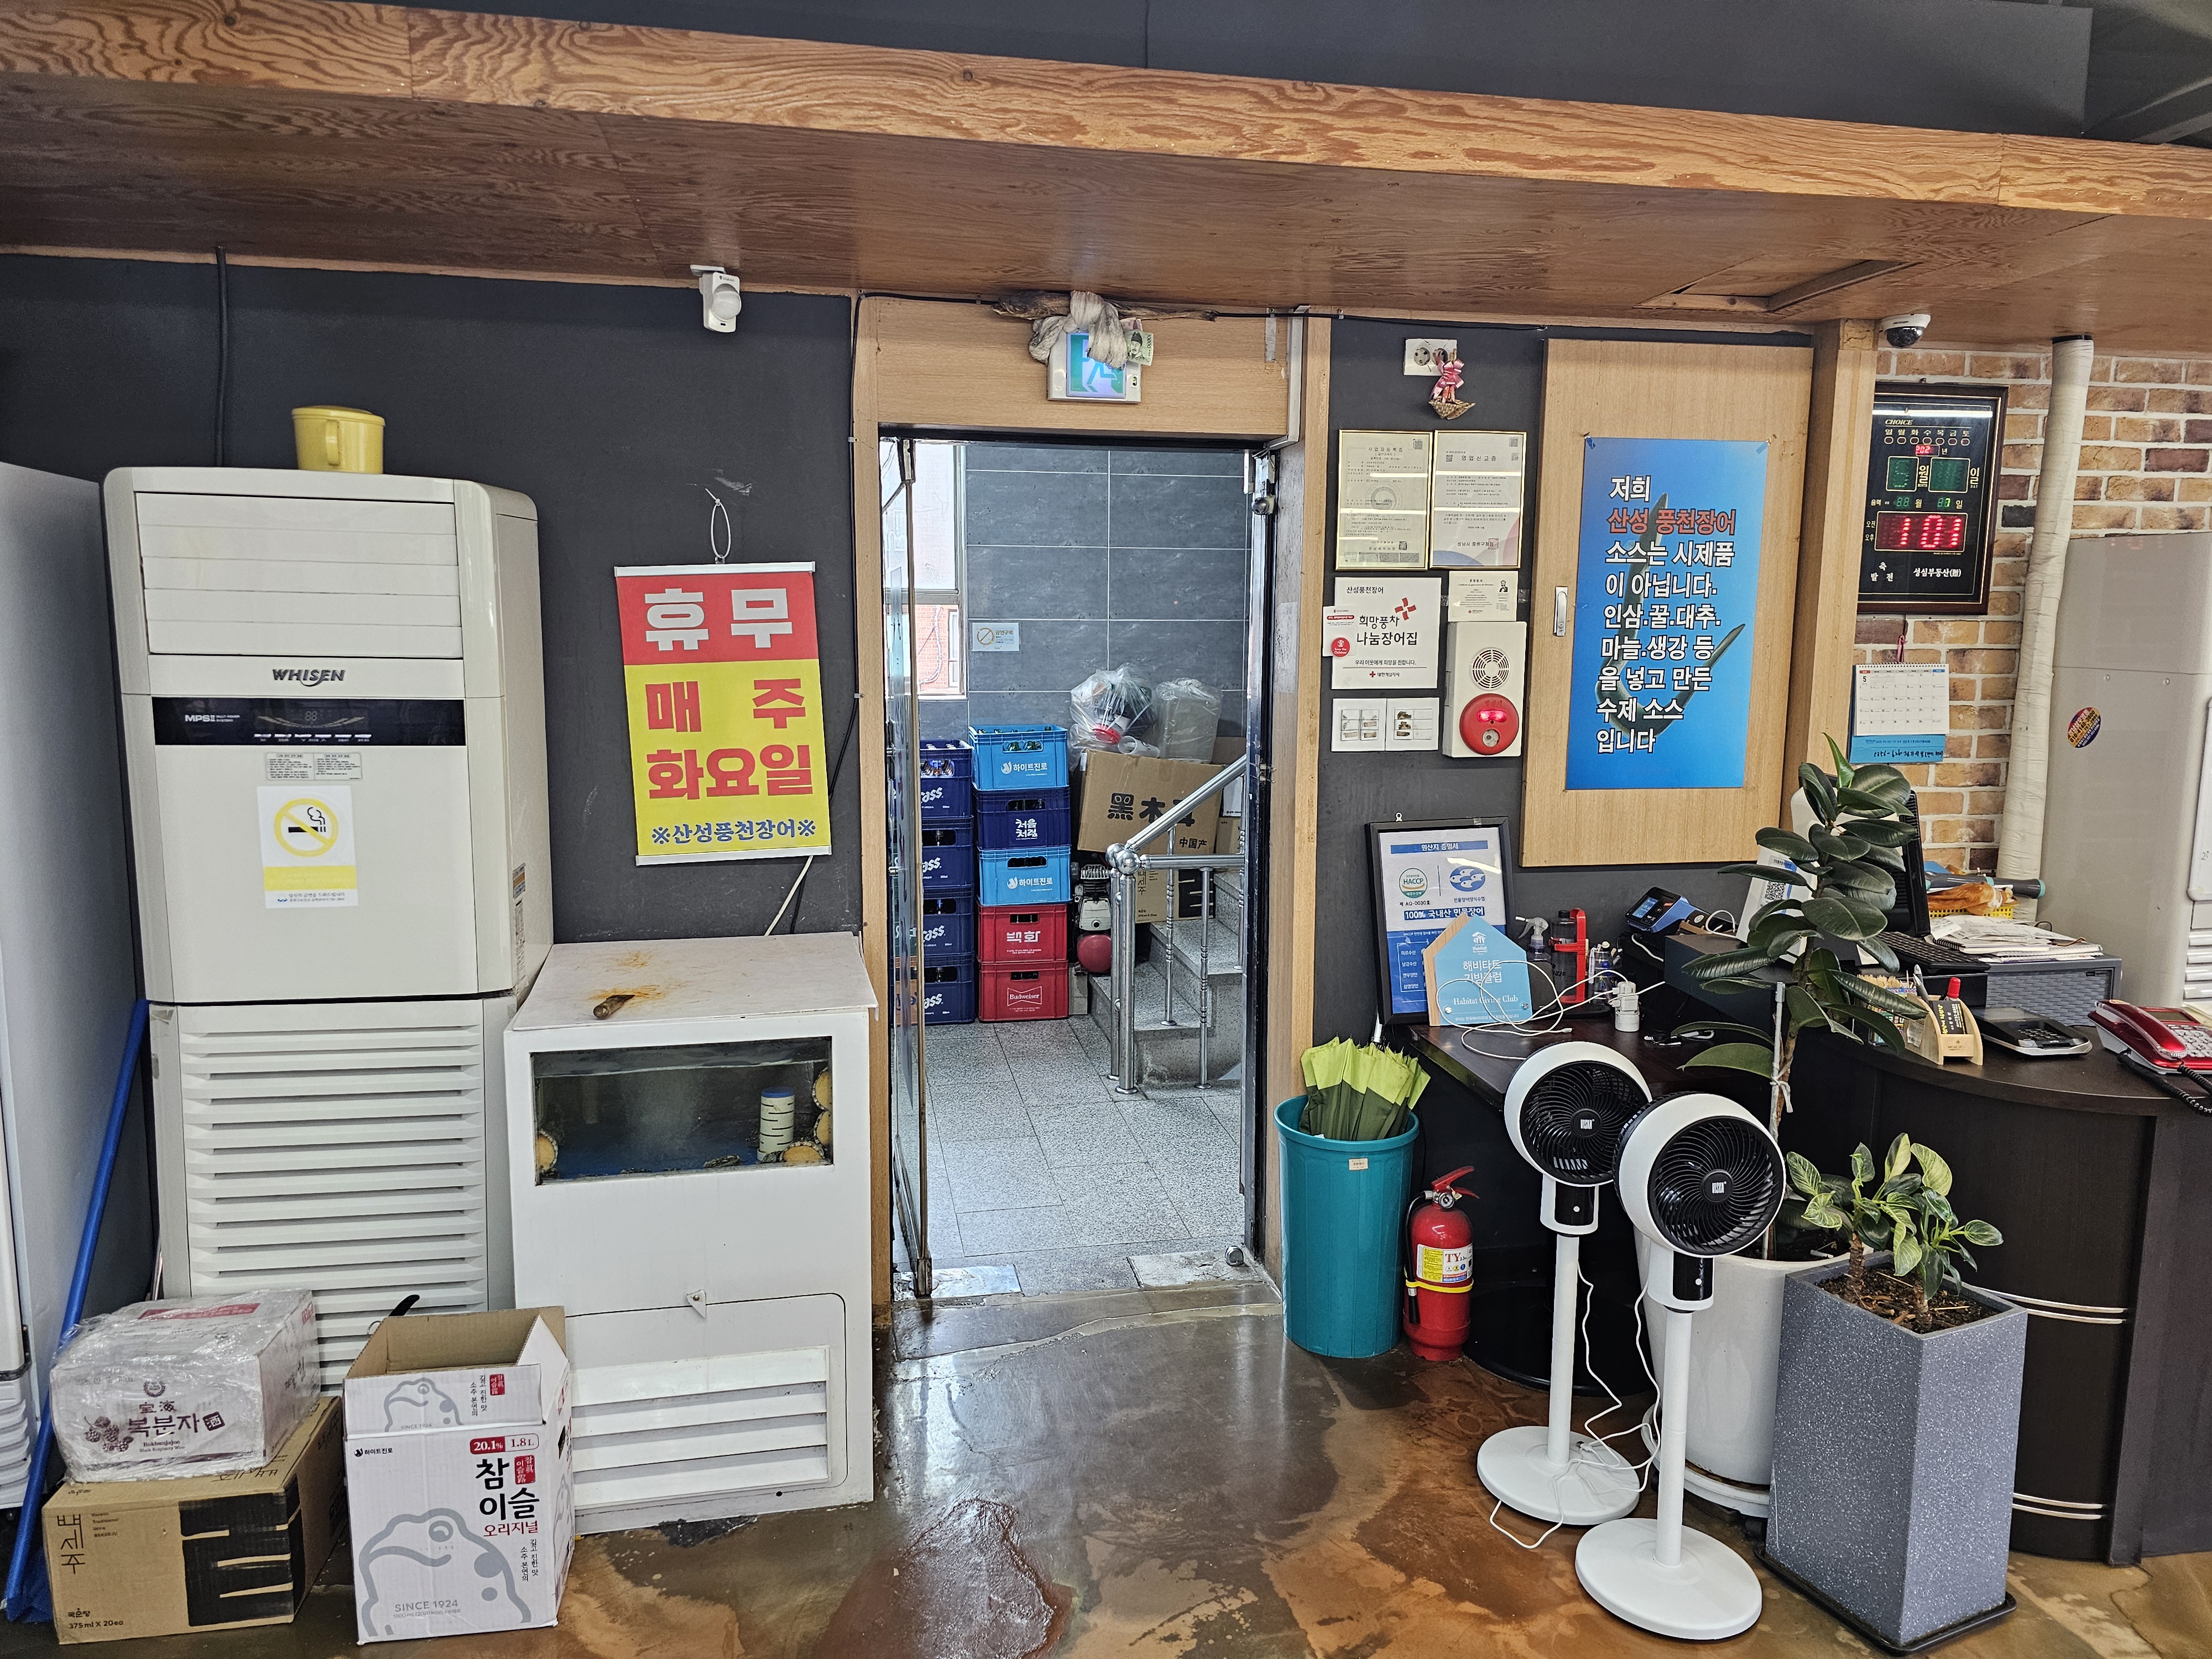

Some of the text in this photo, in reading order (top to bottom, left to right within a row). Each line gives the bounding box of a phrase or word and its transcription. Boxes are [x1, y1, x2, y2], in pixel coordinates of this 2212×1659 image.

[1918, 465, 1929, 484] 월
[1970, 467, 1980, 485] 일
[1609, 475, 1651, 502] 저희
[1915, 499, 1922, 508] 월
[1956, 500, 1963, 509] 일
[1607, 508, 1736, 535] 산성 풍천장어
[1605, 540, 1735, 567] 소스는 시제품
[1879, 562, 1887, 571] 축
[1605, 572, 1718, 598] 이 아닙니다.
[1359, 615, 1400, 629] 희망풍차
[1357, 632, 1417, 646] 나눔장어집
[1601, 635, 1714, 660] 마늘.생강 등
[273, 669, 346, 687] WHISEN
[1598, 666, 1712, 691] 을 넣고 만든
[1597, 697, 1684, 722] 수제 소스
[1597, 728, 1656, 754] 입니다
[646, 744, 813, 800] 화요일
[1013, 763, 1048, 772] 하이트진로
[1015, 818, 1037, 829] 처음
[1016, 829, 1038, 838] 처럼
[1179, 837, 1207, 849] 中国产
[1019, 877, 1053, 886] 하이트진로
[1405, 910, 1426, 920] 100%
[1428, 909, 1452, 919] 국내산
[1463, 960, 1502, 971] 해비타트
[924, 993, 943, 1009] ass
[1580, 1119, 1593, 1129] VISKA
[1712, 1182, 1724, 1193] VISKA
[1445, 1253, 1461, 1262] TY
[479, 1374, 486, 1387] 깊고
[470, 1383, 477, 1394] 소주
[479, 1389, 487, 1403] 진한
[127, 1413, 200, 1437] 복분자
[364, 1447, 393, 1455] 하이트진로
[473, 1440, 504, 1451] 20.1%
[475, 1458, 510, 1490] 참
[479, 1488, 540, 1521] 이슬
[483, 1521, 539, 1537] 오리지널
[57, 1514, 86, 1575] 백세주
[530, 1538, 538, 1552] 깊고
[520, 1546, 529, 1582] 소주 본연의
[530, 1554, 539, 1568] 진한
[395, 1599, 459, 1612] SINCE 1924
[69, 1621, 94, 1630] 375ml
